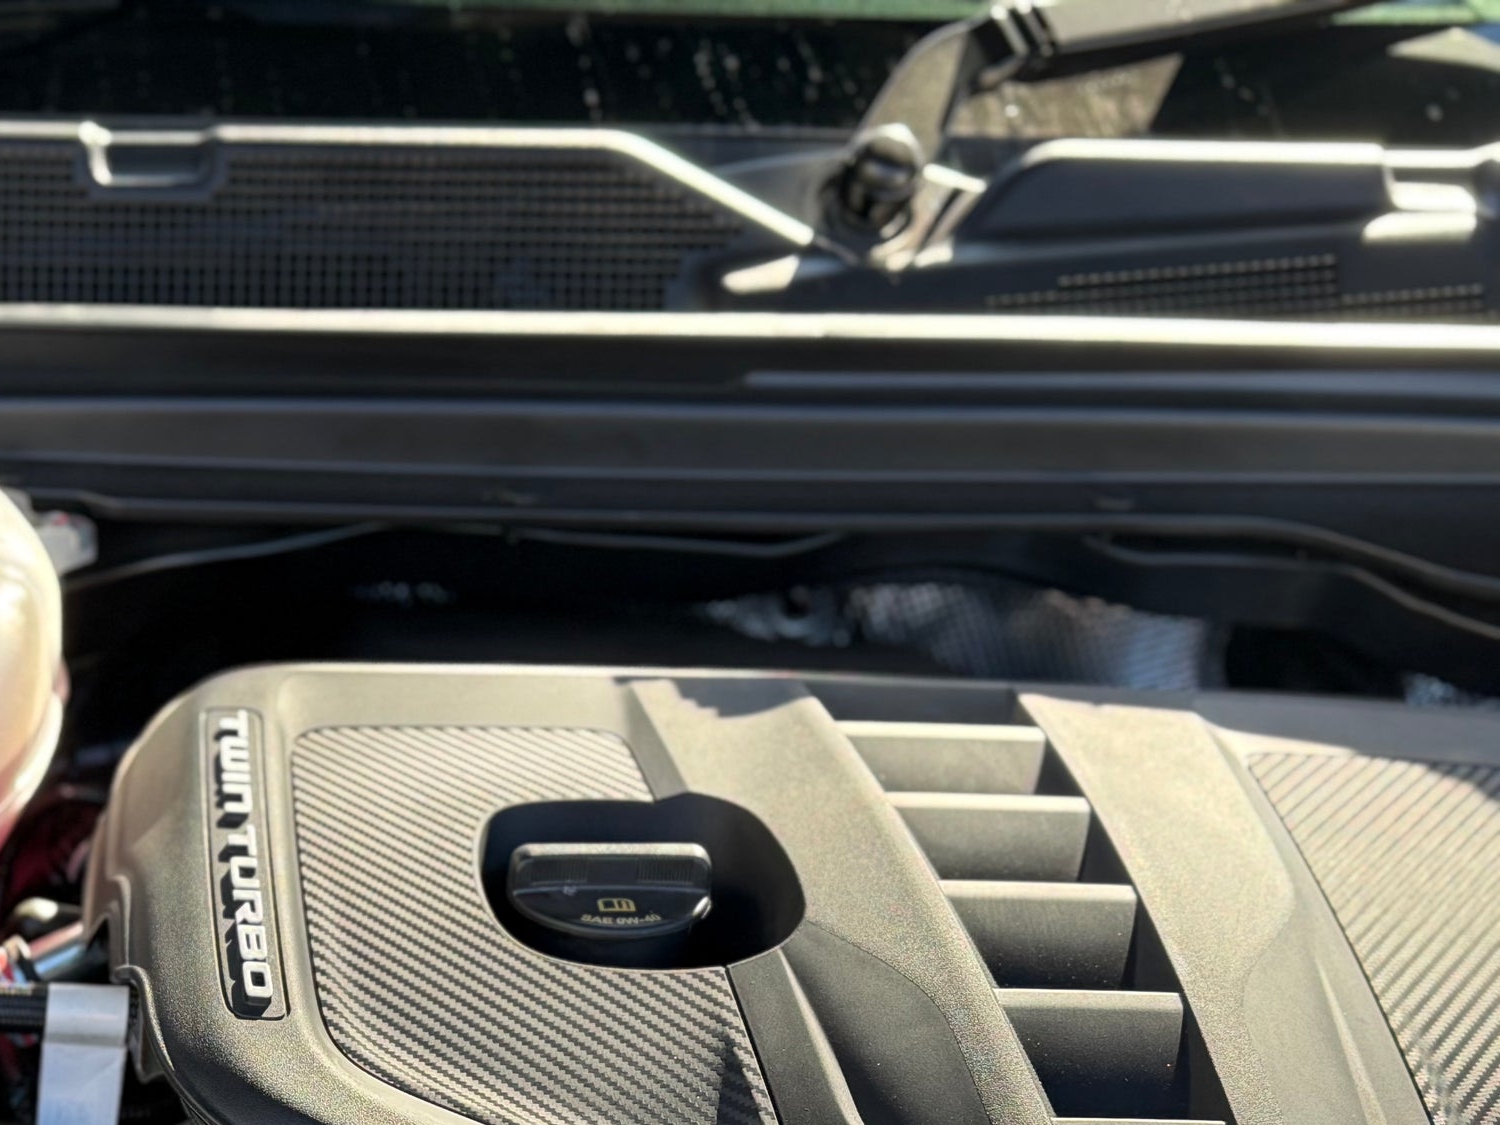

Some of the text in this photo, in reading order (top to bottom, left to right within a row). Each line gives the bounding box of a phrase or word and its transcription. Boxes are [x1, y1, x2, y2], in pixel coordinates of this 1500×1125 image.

[218, 710, 274, 999] TWIN TURBO
[580, 914, 613, 925] SAE
